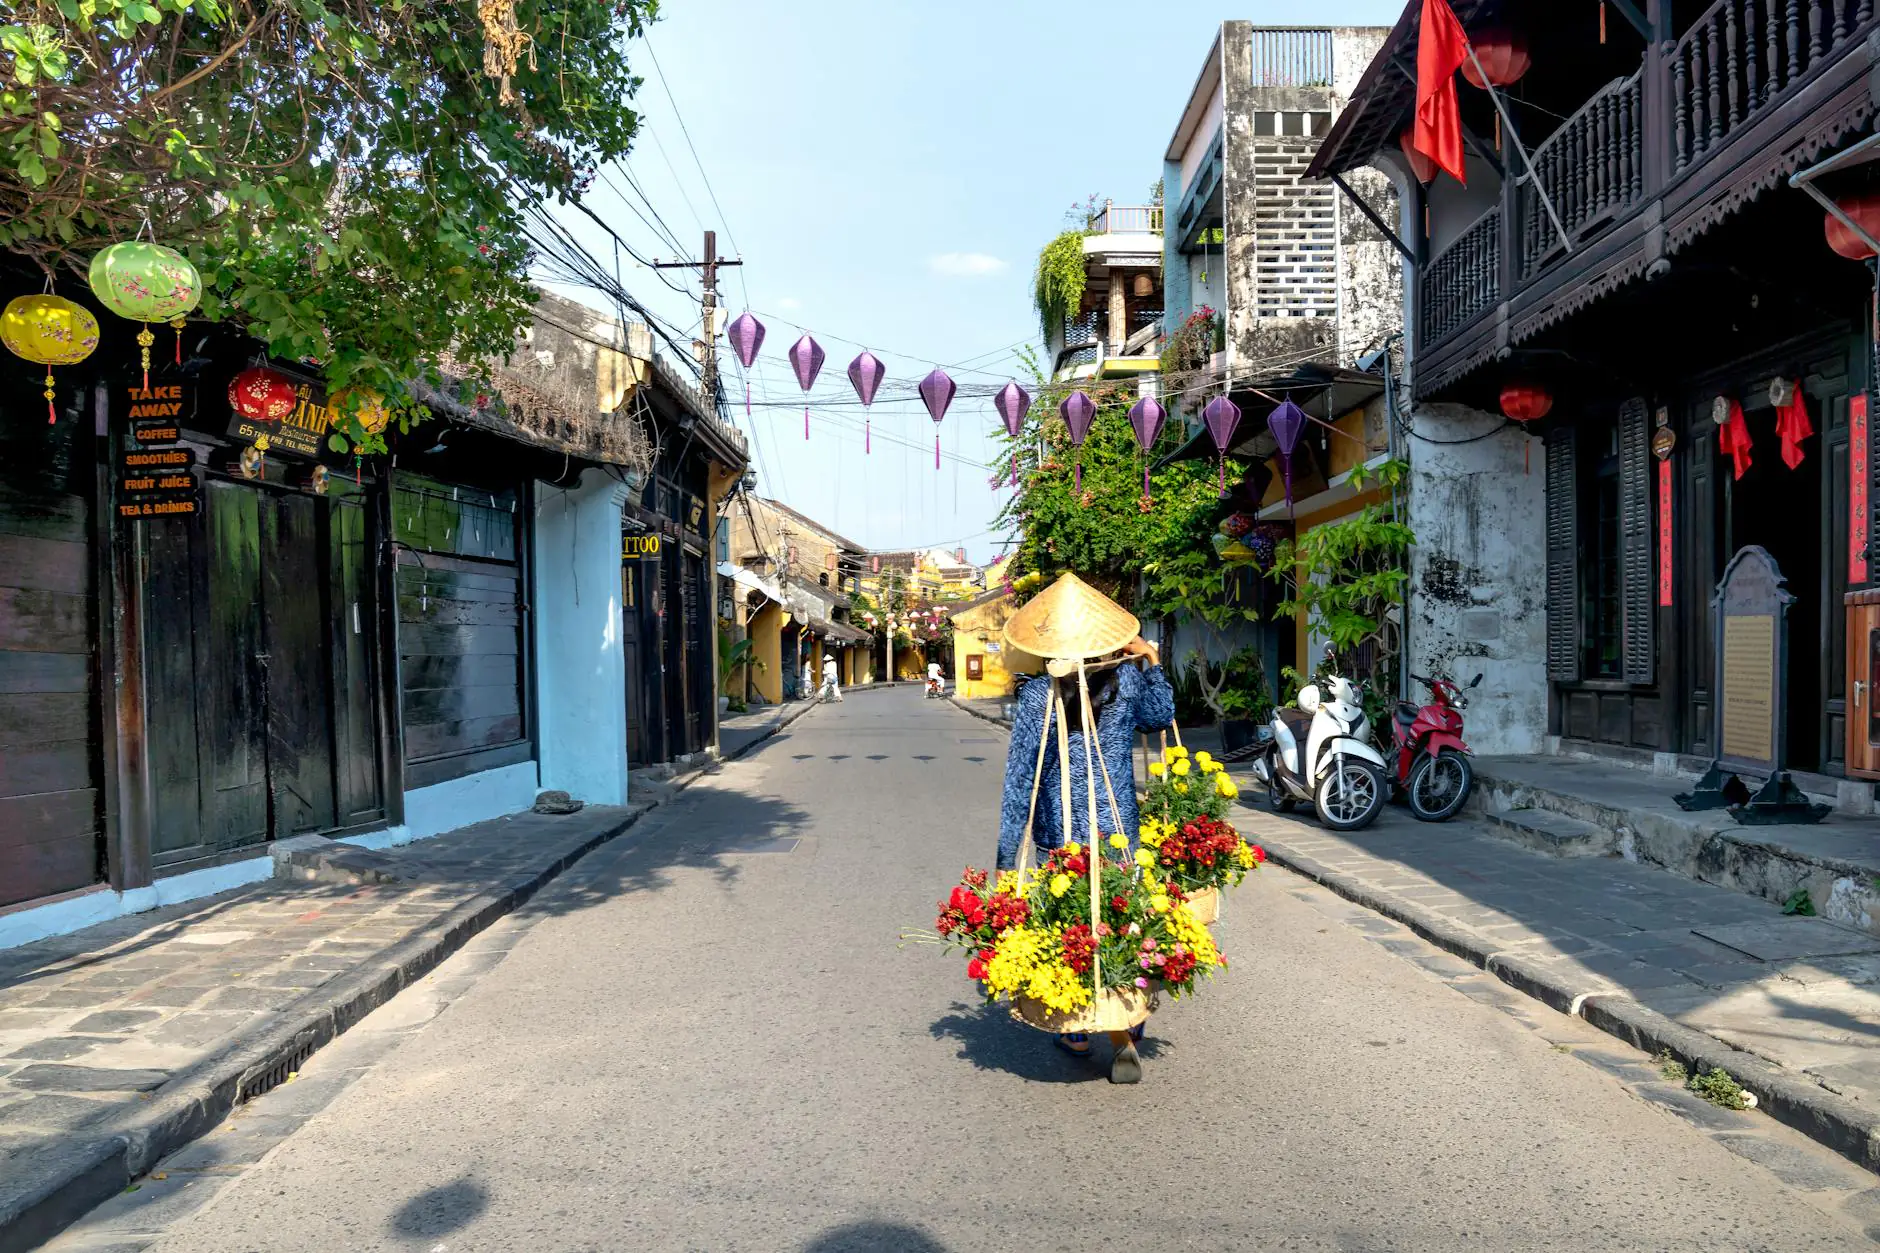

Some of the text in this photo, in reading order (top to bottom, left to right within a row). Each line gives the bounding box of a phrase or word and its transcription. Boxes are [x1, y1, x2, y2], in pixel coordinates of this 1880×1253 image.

[127, 386, 182, 400] TAKE
[128, 402, 182, 418] AWAY
[136, 428, 177, 440] COFFEE
[239, 424, 255, 437] 65
[120, 505, 142, 516] TEA
[142, 504, 153, 515] &
[622, 536, 660, 553] TTOO
